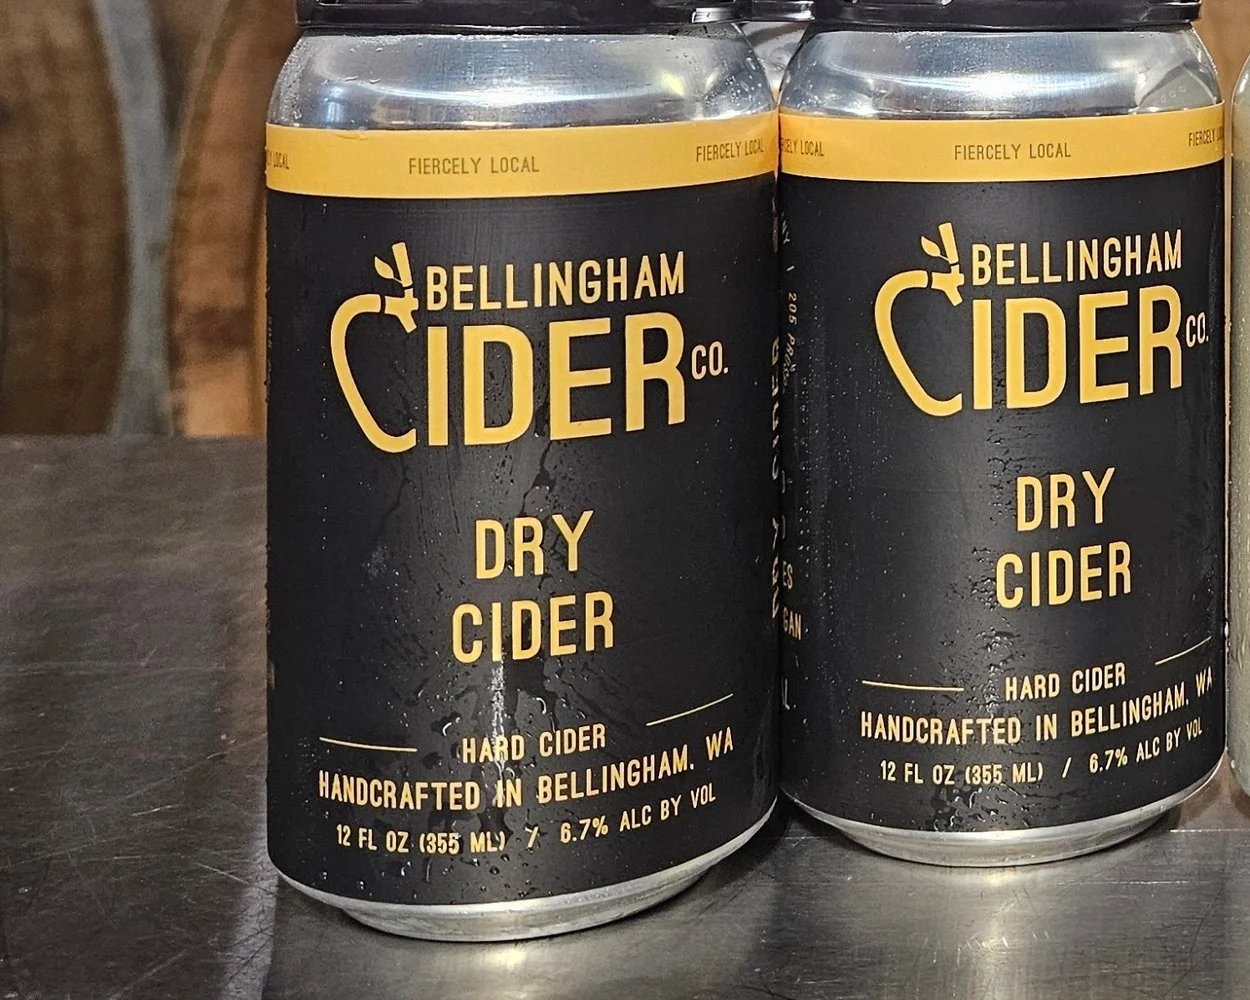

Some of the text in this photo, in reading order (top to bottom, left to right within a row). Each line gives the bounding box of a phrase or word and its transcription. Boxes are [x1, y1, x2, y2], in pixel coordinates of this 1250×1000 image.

[408, 155, 540, 175] FIERCELY LOCAL
[696, 137, 764, 163] FIERCELY LOCAL
[800, 139, 824, 157] LOCAL
[954, 143, 1071, 161] FIERCELY LOCAL
[426, 251, 685, 312] BELLINGHAM
[972, 229, 1182, 286] BELLINGHAM
[331, 312, 685, 453] CIDER
[691, 341, 729, 381] CO.
[874, 284, 1210, 417] CIDER CO.
[1016, 467, 1115, 533] DRY
[475, 510, 593, 579] DRY
[995, 541, 1132, 609] CIDER
[452, 591, 615, 664] CIDER
[861, 712, 1021, 745] HANDCRAFTED
[1036, 713, 1057, 741] IN
[1196, 666, 1213, 696] WA
[1005, 663, 1126, 701] HARD CIDER
[319, 770, 480, 811] HANDCRAFTED
[495, 778, 522, 808] IN
[706, 727, 734, 761] WA
[462, 724, 606, 764] HARD CIDER
[880, 717, 1202, 785] 12 FL OZ (355 ML) / 6.7% ALC BY VOL
[336, 782, 716, 855] 12 FL OZ (355 ML) / 6.7% ALC BY VOL
